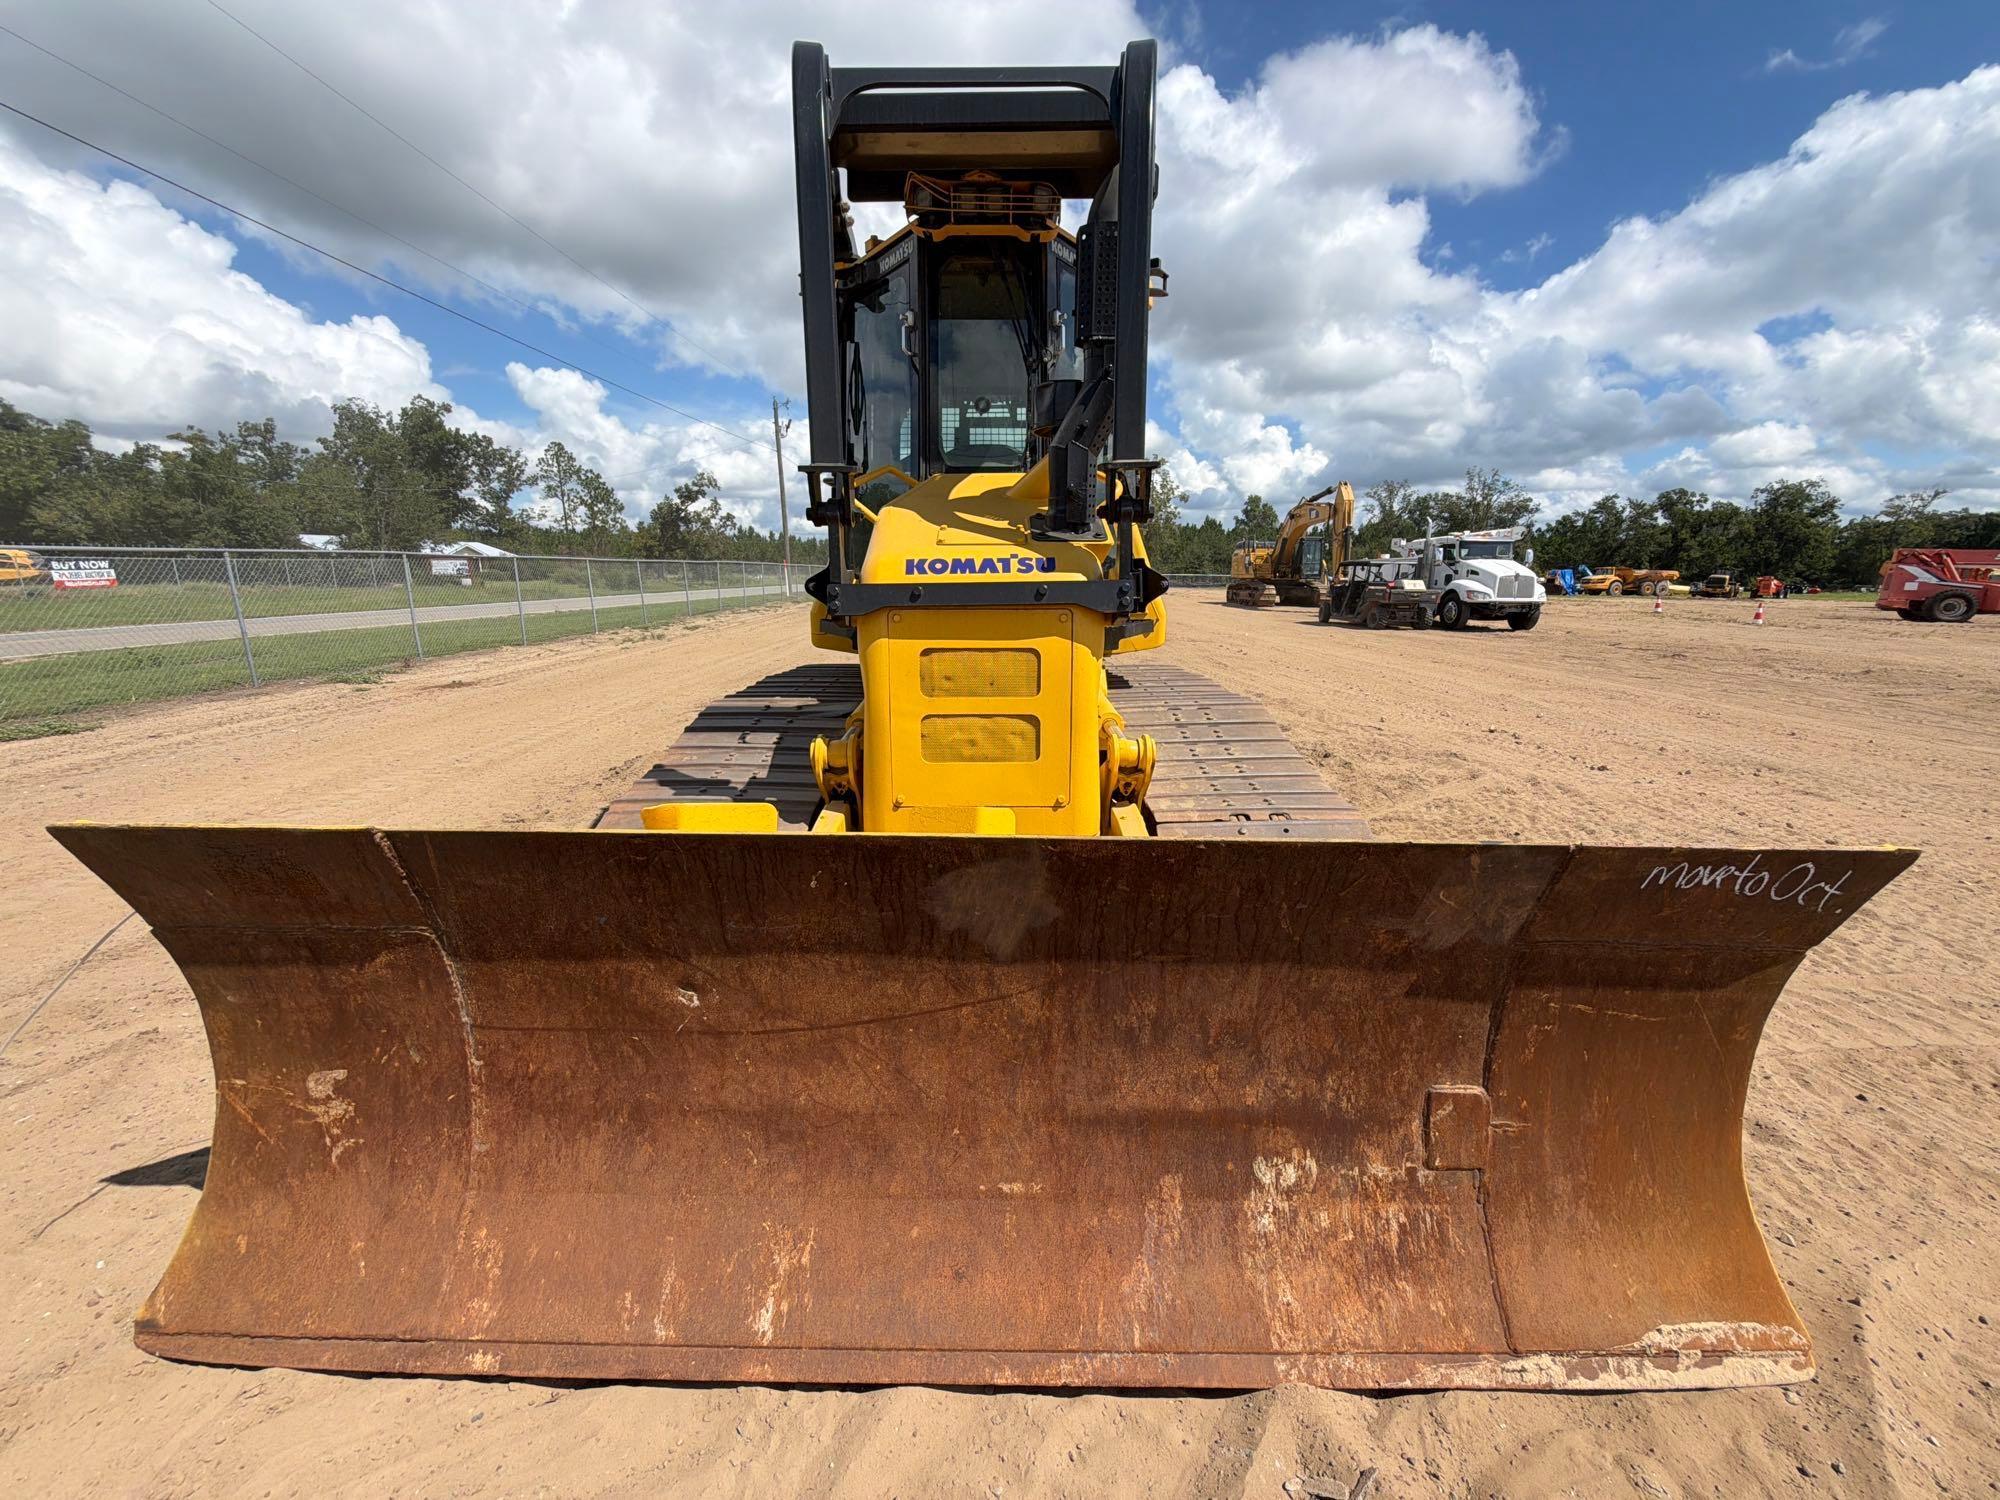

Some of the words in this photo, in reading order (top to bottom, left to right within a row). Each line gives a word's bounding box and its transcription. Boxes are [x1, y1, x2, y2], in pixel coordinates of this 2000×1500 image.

[880, 239, 914, 273] KOMATSU
[1051, 239, 1077, 265] KOMA
[51, 560, 76, 570] BUY
[79, 560, 109, 570] NOW
[905, 553, 1057, 576] KOMATSU
[1733, 853, 1770, 897] to
